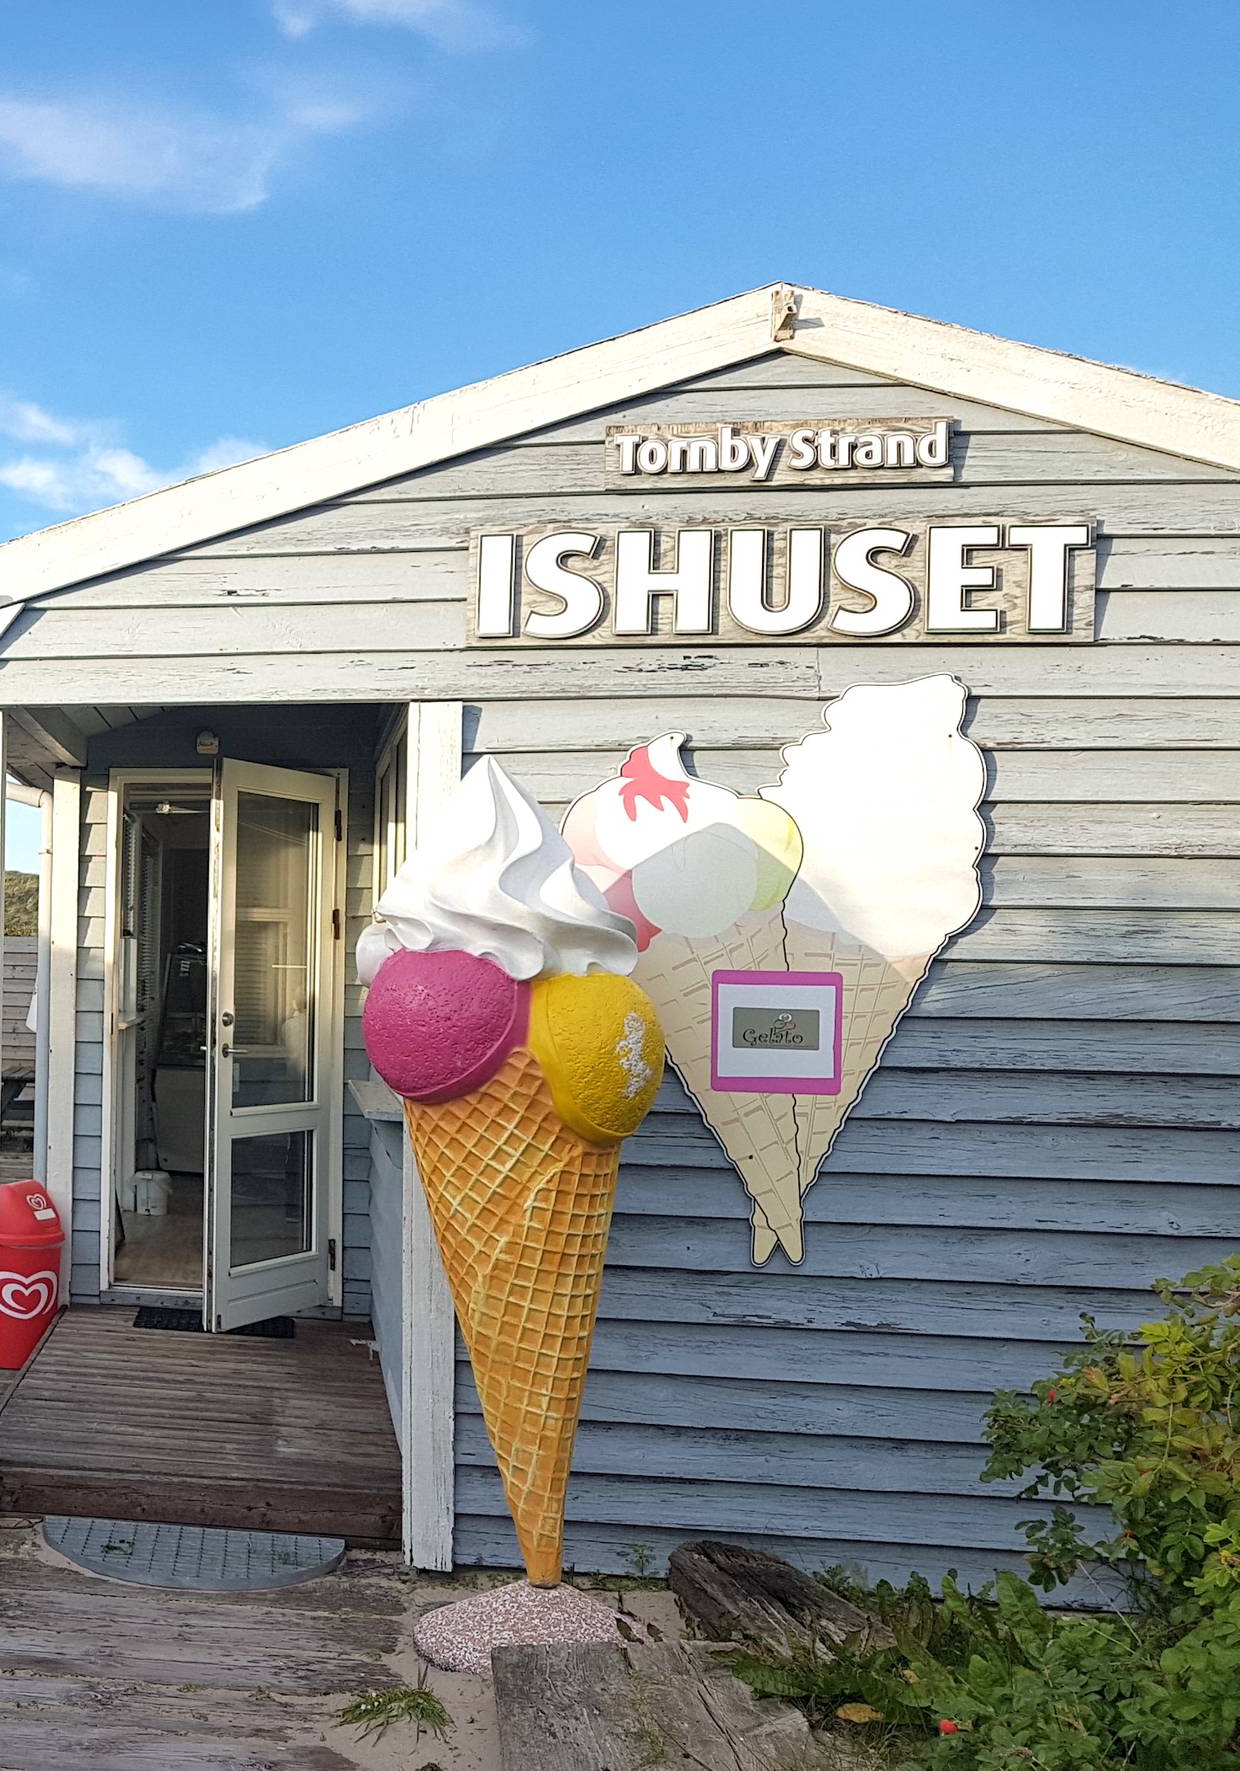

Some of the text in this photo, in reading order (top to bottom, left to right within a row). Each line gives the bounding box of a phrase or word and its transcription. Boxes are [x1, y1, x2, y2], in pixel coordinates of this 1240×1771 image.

[616, 420, 949, 480] Tornby Strand
[476, 524, 1090, 637] ISHUSET
[743, 1028, 803, 1046] Gelato
